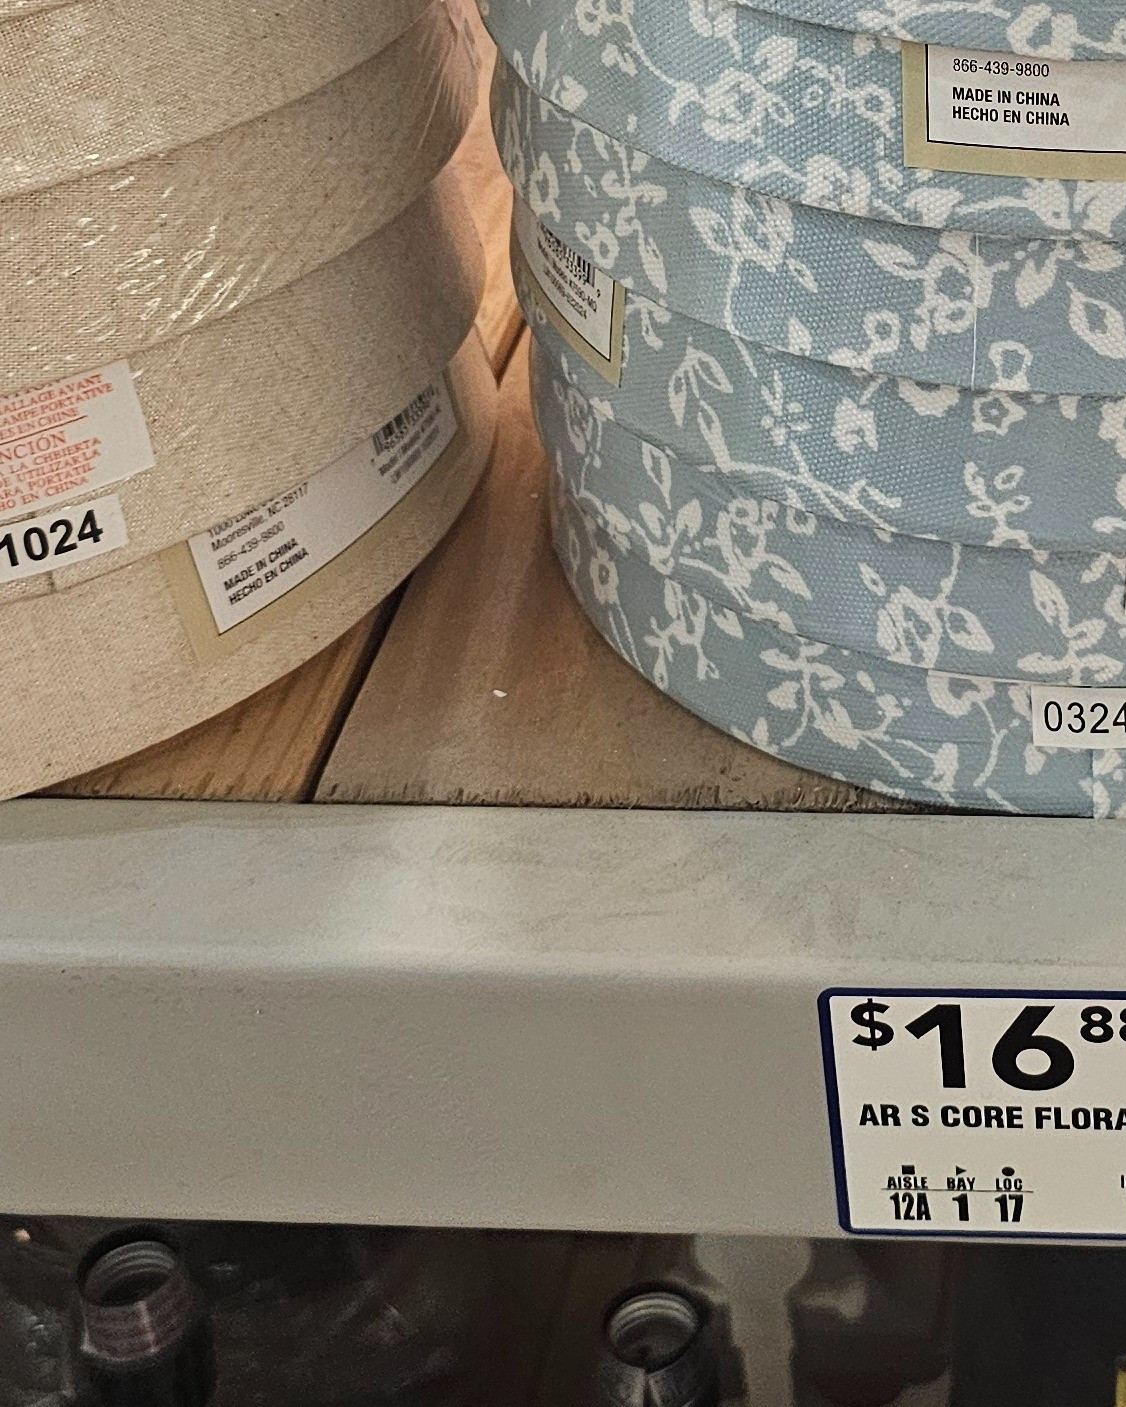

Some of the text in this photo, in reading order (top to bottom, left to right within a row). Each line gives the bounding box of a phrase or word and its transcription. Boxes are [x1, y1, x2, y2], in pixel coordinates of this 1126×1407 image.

[953, 58, 1049, 77] 866-439-9800
[953, 87, 1060, 106] MADE IN CHINA
[953, 106, 1070, 126] HECHO EN CHINA
[0, 509, 103, 567] 1024
[859, 1103, 902, 1127] AR
[911, 1105, 930, 1128] S
[940, 1106, 1024, 1128] CORE
[887, 1176, 928, 1189] AISLE
[947, 1177, 975, 1190] BAY
[995, 1178, 1023, 1190] LOC
[890, 1193, 931, 1220] 12A
[952, 1193, 969, 1221] 1
[995, 1194, 1023, 1222] 17
